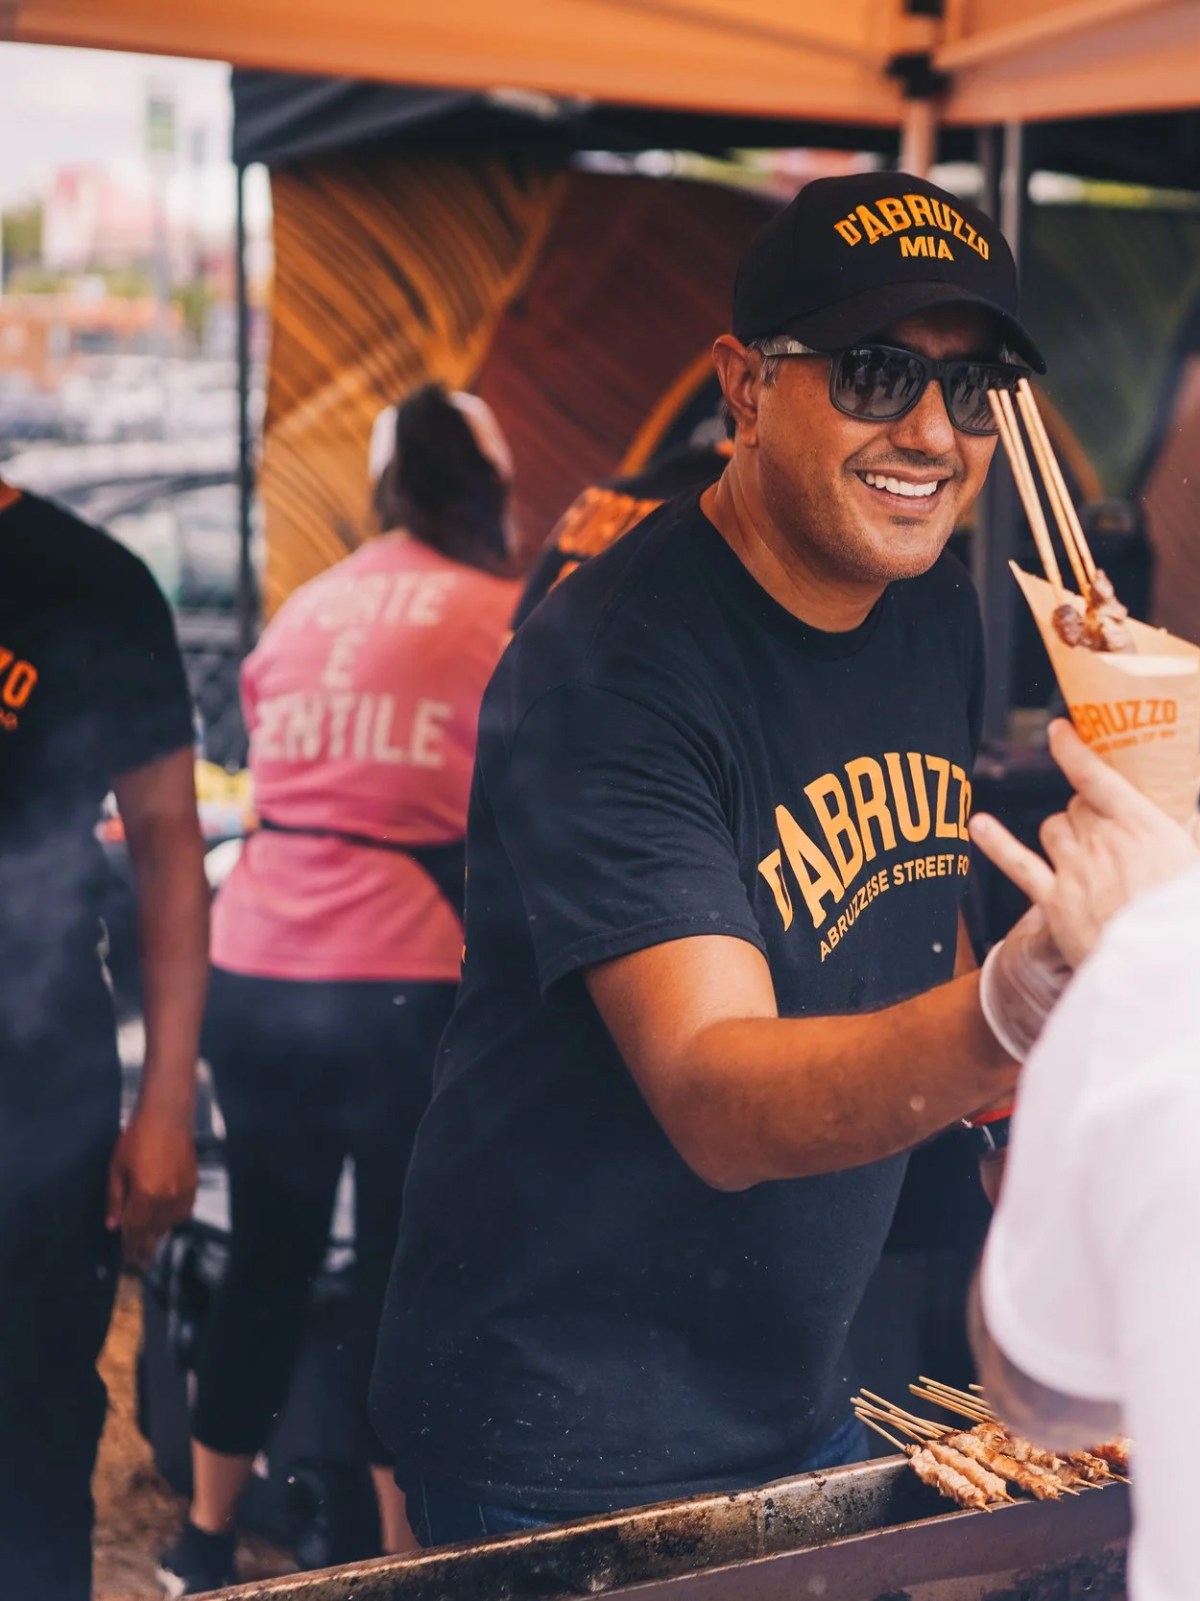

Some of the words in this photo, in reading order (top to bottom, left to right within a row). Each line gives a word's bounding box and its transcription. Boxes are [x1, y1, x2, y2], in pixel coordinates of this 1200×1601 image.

[834, 194, 989, 261] D'ABRUZZO
[900, 236, 954, 261] MIA
[819, 869, 889, 962] ABRUZZESE
[893, 854, 954, 886] STREET
